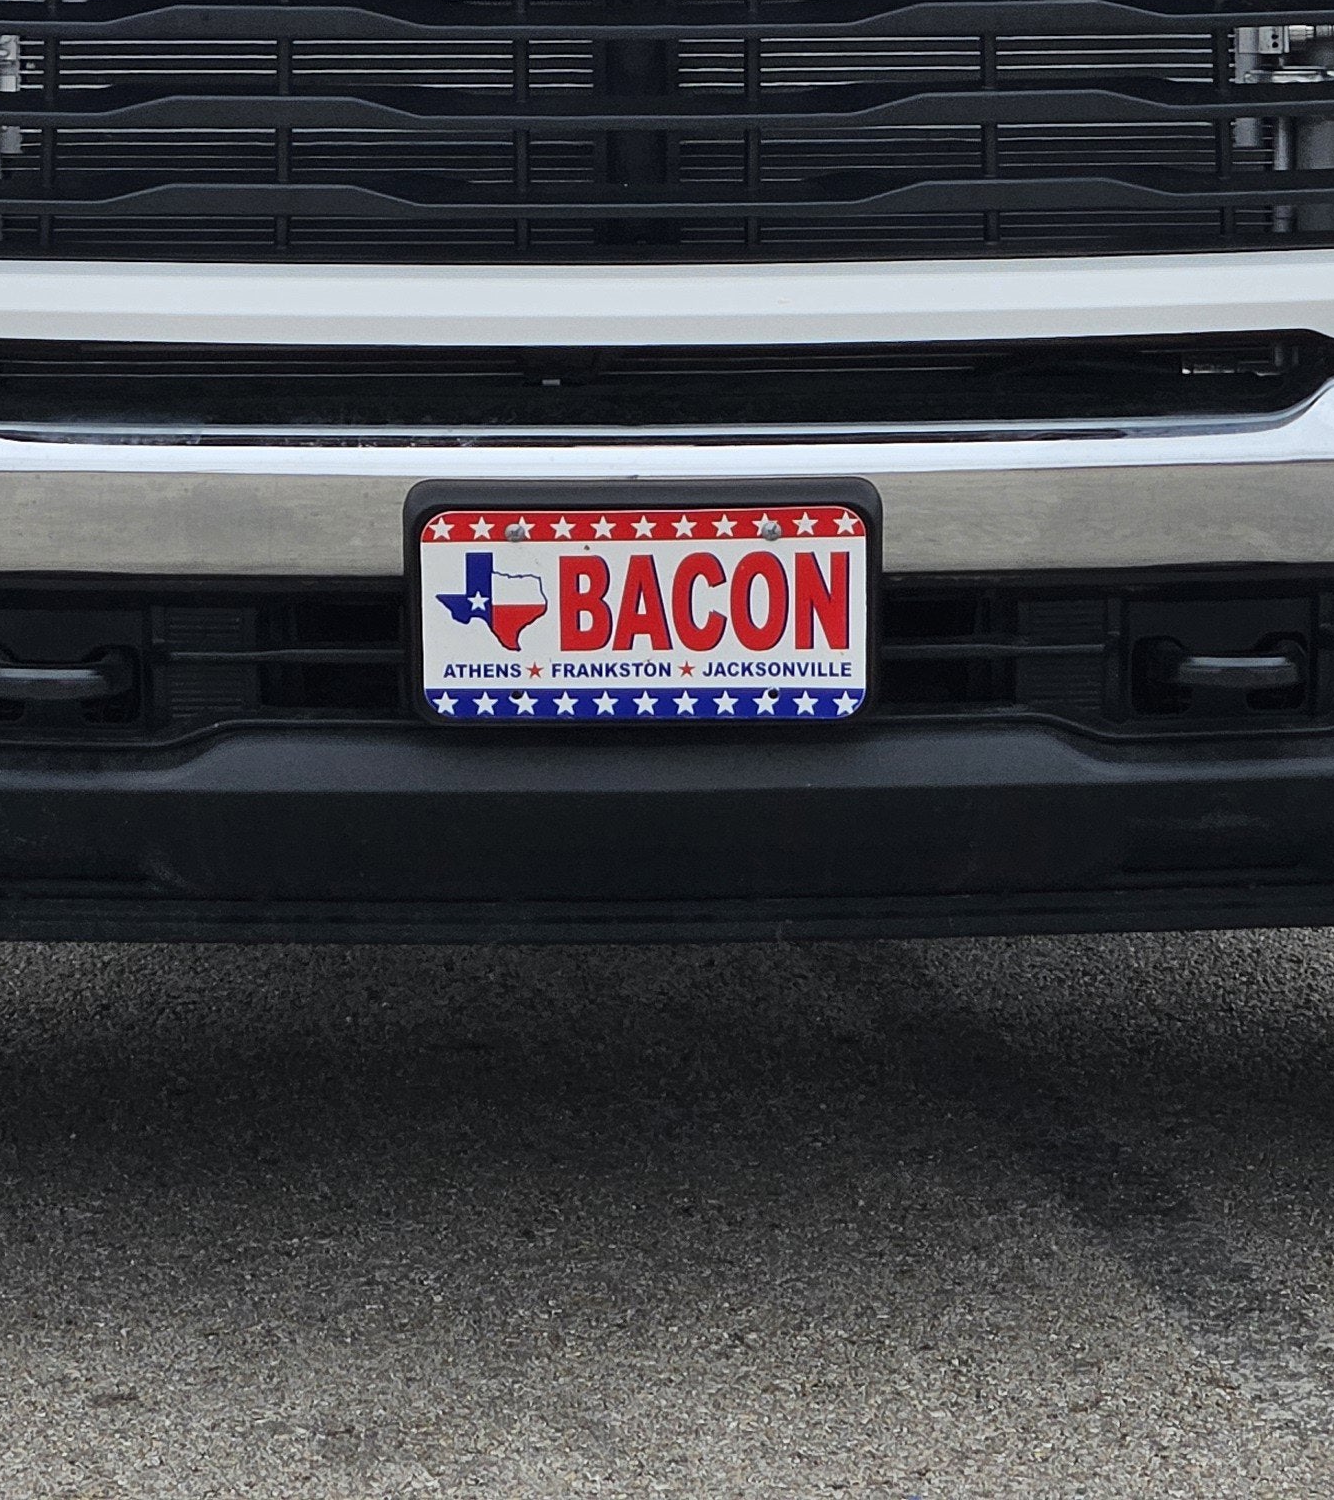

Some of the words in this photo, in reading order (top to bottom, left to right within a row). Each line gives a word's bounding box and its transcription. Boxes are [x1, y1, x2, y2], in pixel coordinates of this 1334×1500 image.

[559, 551, 850, 652] BACON
[442, 662, 522, 680] ATHENS
[550, 661, 672, 679] FRANKSTON
[702, 660, 853, 679] JACKSONVILLE
